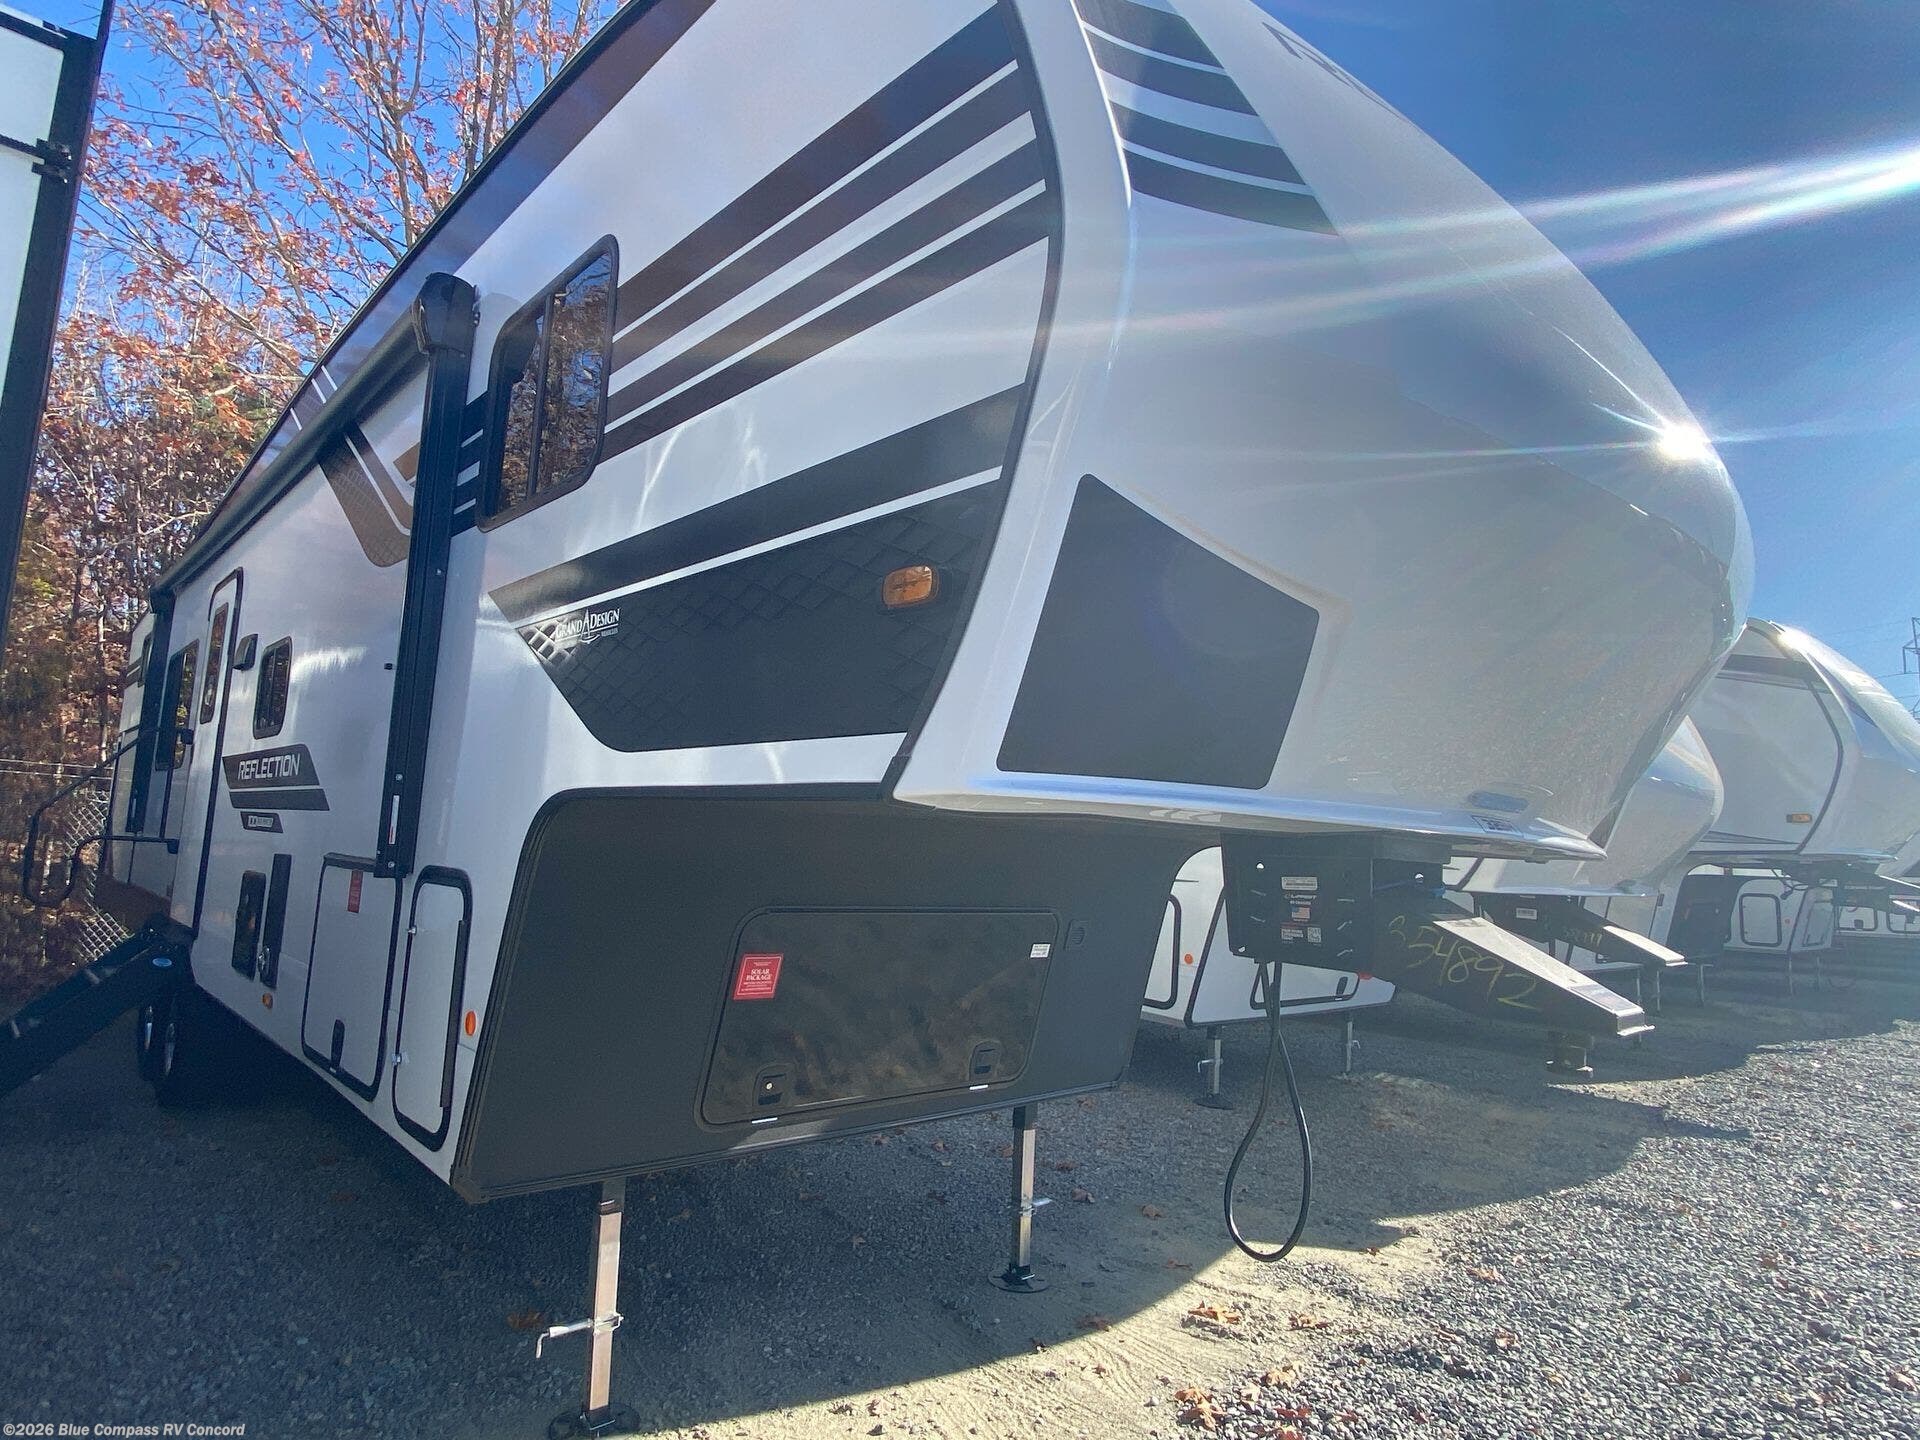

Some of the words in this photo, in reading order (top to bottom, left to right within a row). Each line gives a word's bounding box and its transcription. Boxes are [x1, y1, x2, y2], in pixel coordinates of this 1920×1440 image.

[555, 619, 582, 639] GRAND
[590, 608, 620, 629] DESIGN
[237, 753, 300, 780] REFLECTION
